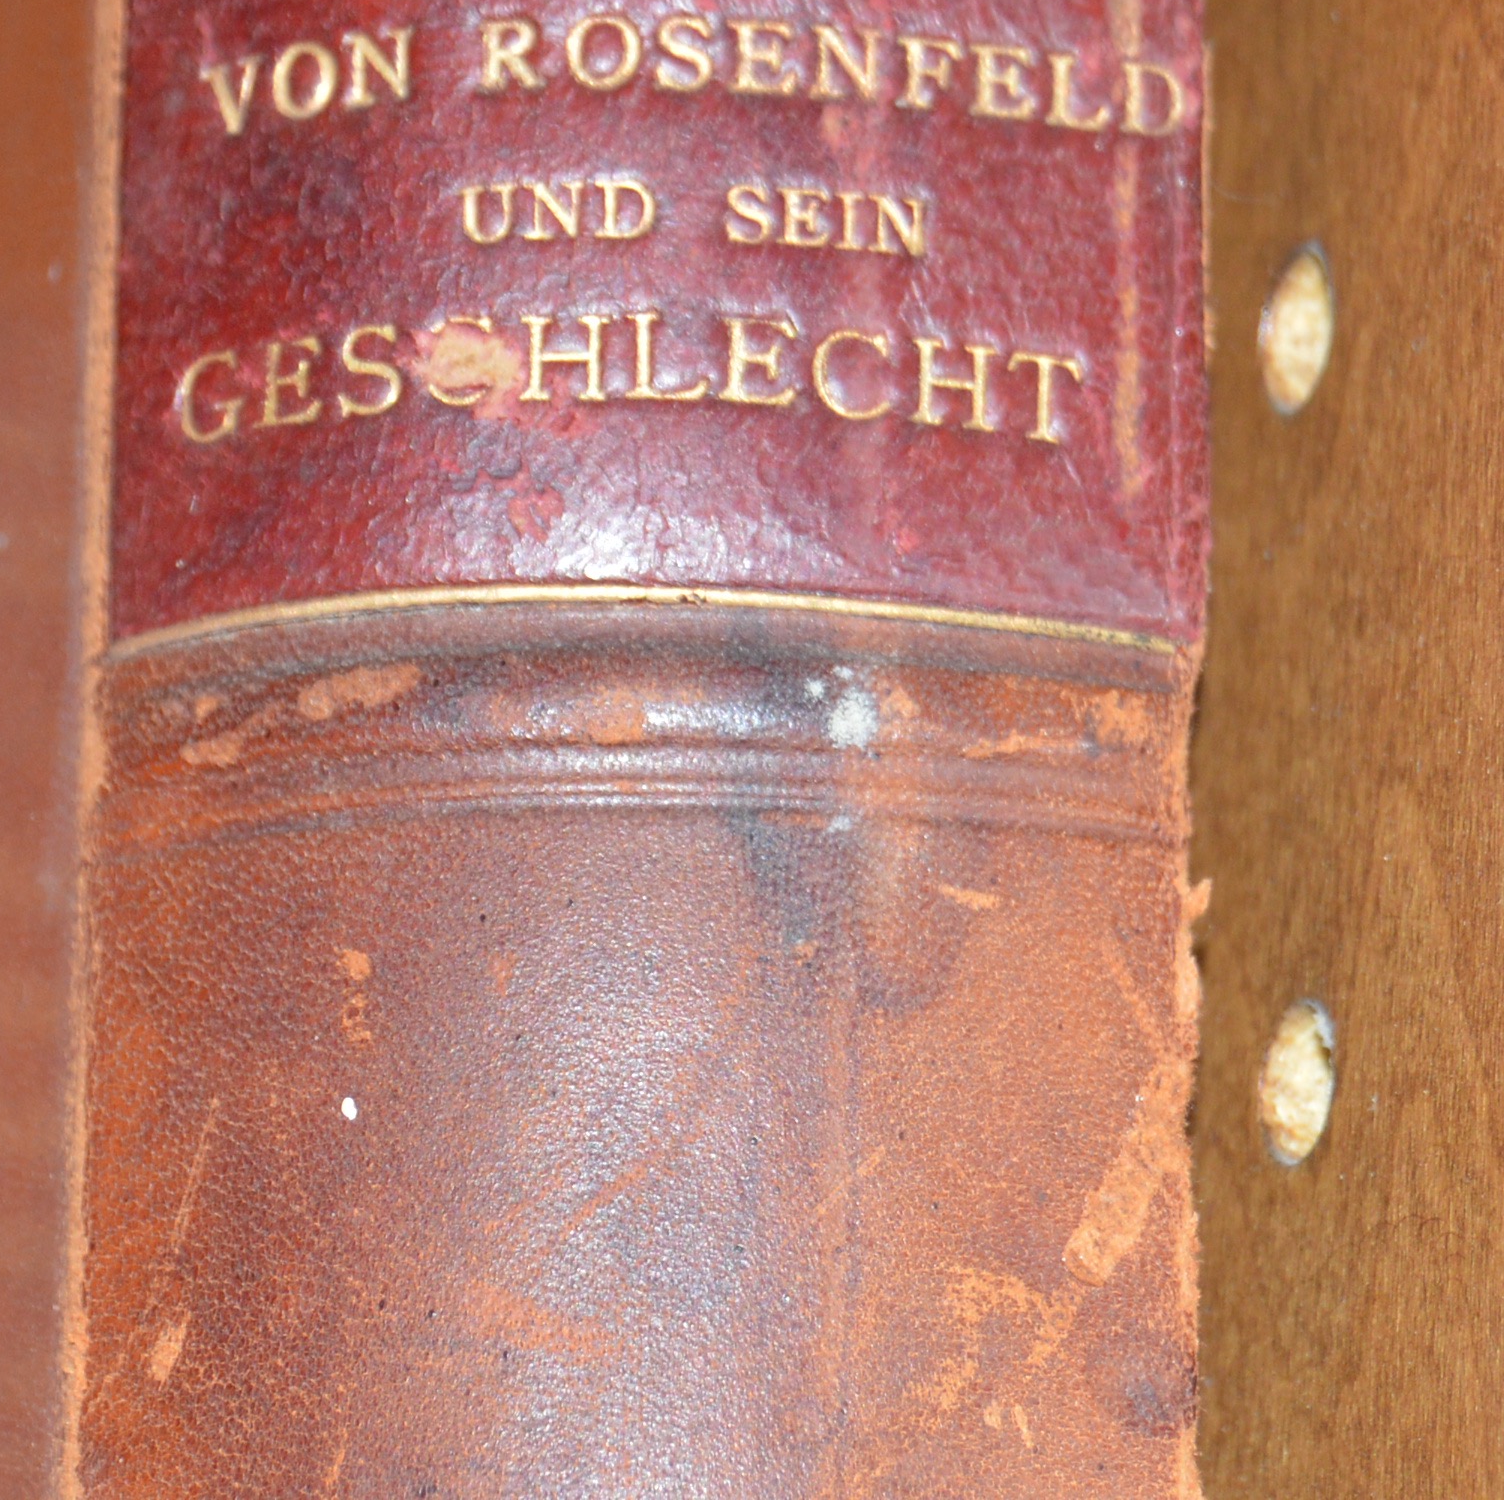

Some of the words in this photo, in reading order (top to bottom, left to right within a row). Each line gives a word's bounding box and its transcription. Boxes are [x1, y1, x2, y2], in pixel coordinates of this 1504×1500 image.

[200, 25, 413, 136] VON
[480, 14, 1184, 140] ROSENFELD
[460, 180, 659, 244] UND
[722, 184, 926, 258] SEIN
